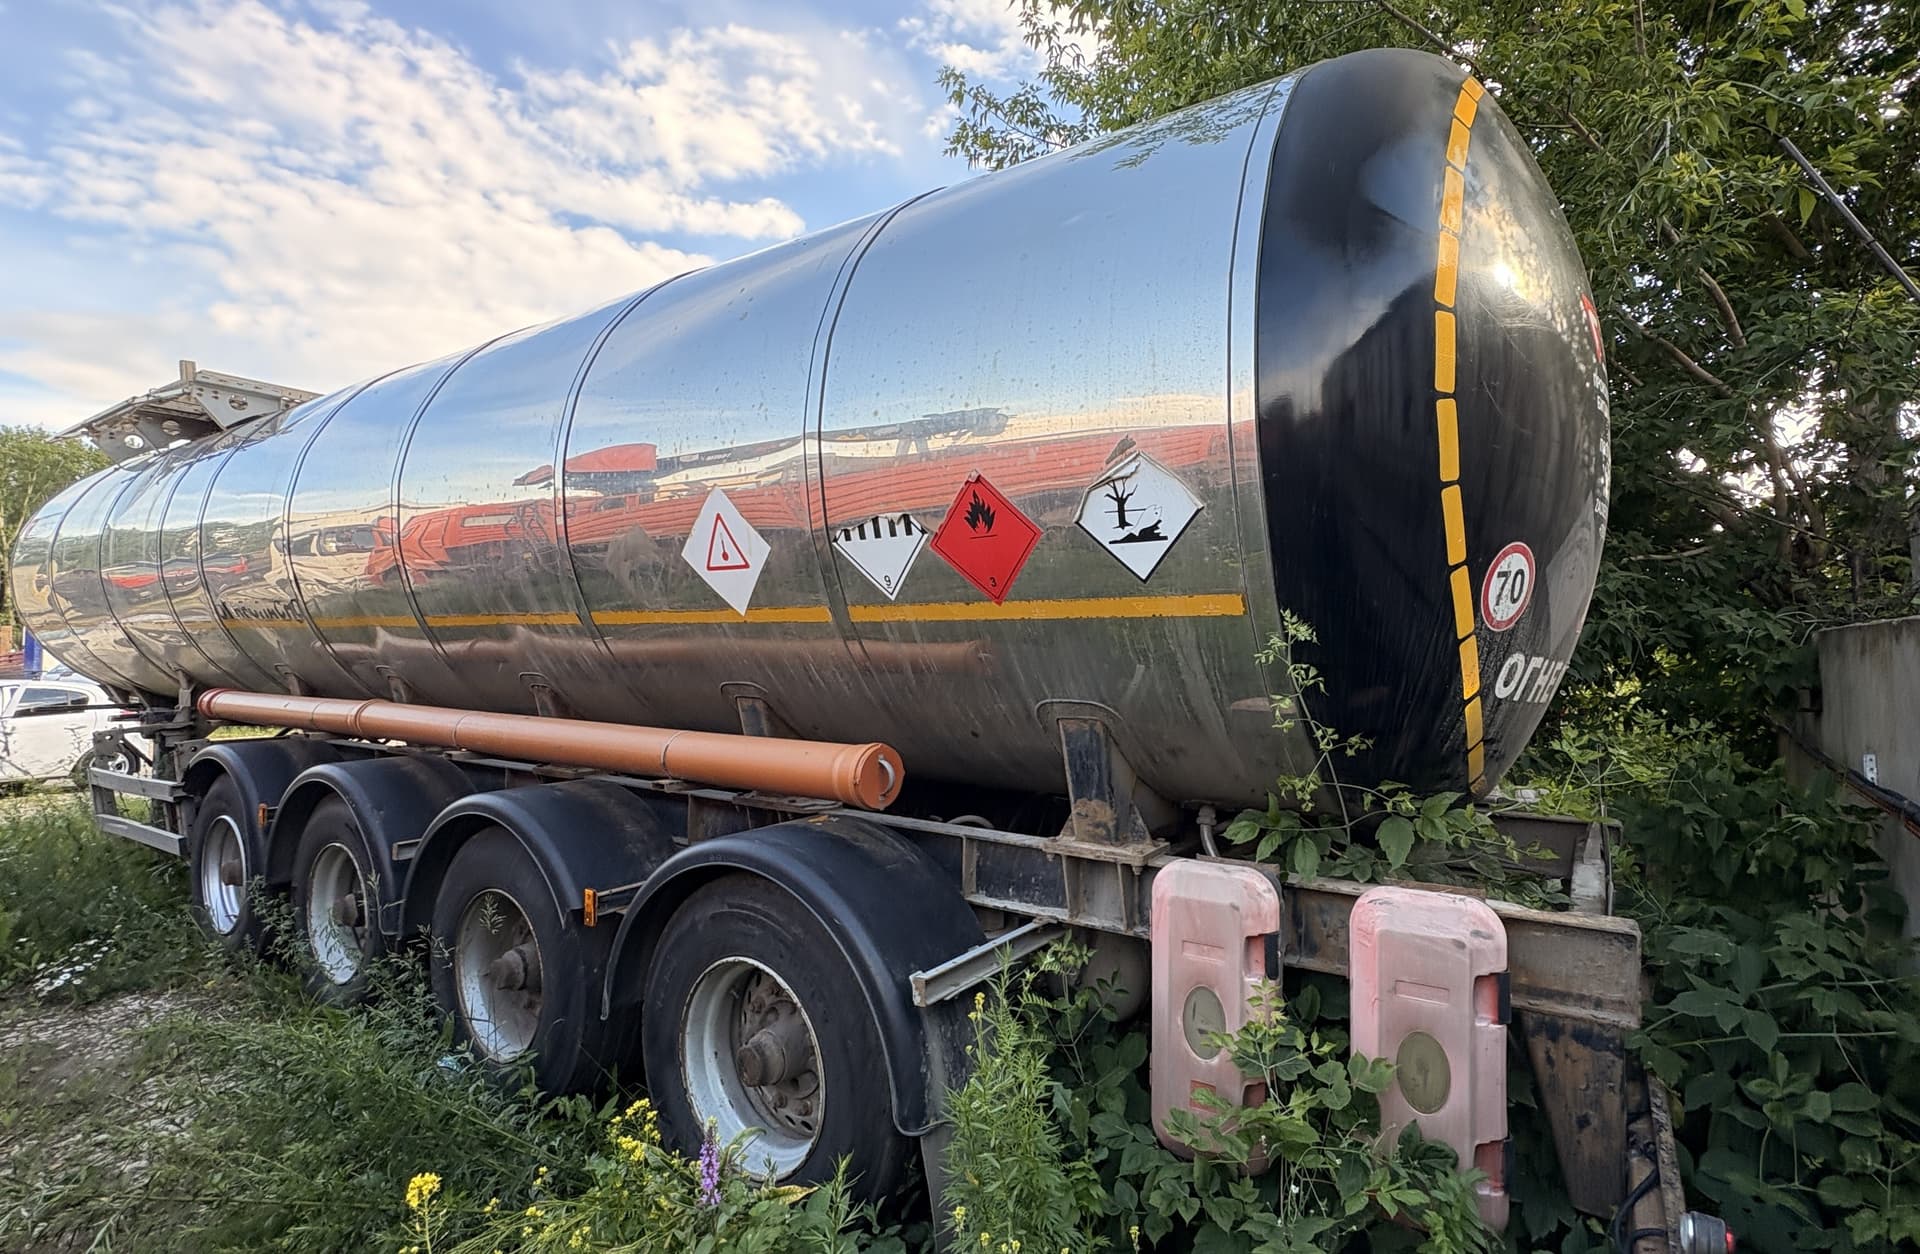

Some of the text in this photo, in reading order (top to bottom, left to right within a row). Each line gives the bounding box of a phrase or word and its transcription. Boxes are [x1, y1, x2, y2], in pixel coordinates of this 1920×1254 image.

[883, 575, 892, 588] 9
[989, 576, 997, 588] 3
[1495, 568, 1526, 606] 70
[1494, 652, 1569, 703] ОГНЕ
